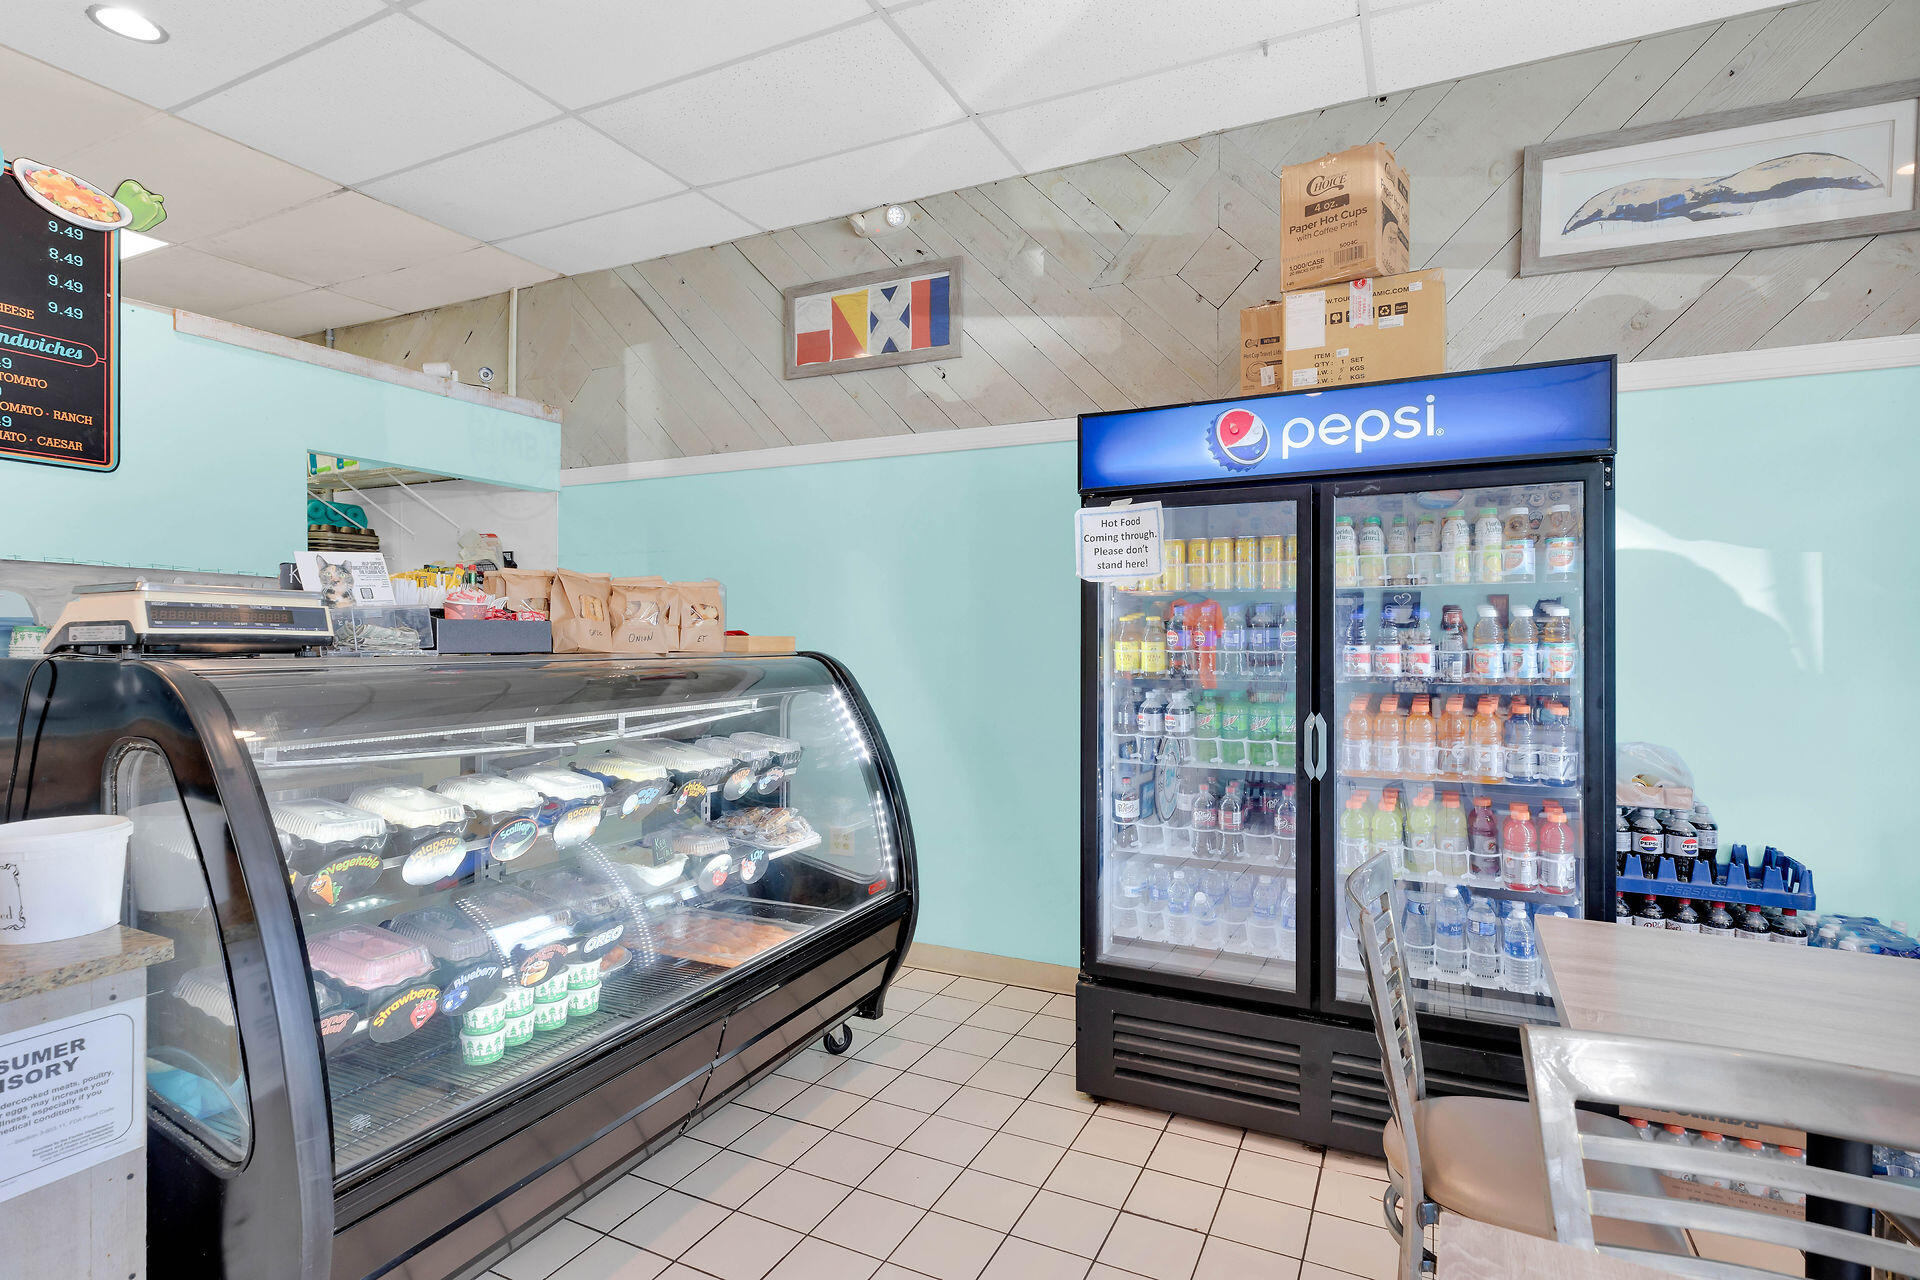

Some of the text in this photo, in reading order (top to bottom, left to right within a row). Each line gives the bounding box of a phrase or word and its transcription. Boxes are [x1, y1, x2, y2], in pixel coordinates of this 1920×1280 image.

[1323, 200, 1338, 210] oz.
[1289, 206, 1368, 235] Paper Hot Cups
[48, 220, 84, 241] 9.49
[1296, 220, 1358, 242] with Coffee Print
[49, 247, 84, 267] 8.49
[48, 274, 84, 293] 9.49
[48, 301, 84, 320] 9.49
[53, 410, 93, 425] RANCH
[37, 436, 83, 451] CAESAR
[1101, 516, 1141, 528] Hot Food
[1083, 530, 1157, 543] Coming through.
[1094, 545, 1149, 556] Please don't
[1097, 558, 1149, 570] stand here!
[326, 855, 380, 874] Vegetable
[454, 966, 498, 989] Blueberry
[373, 988, 440, 1027] Strawberry
[0, 1070, 115, 1111] dercooked meats, poultry,
[5, 1105, 28, 1118] eggs
[31, 1099, 49, 1109] may
[52, 1086, 89, 1102] increase
[91, 1079, 110, 1090] your
[32, 1095, 77, 1117] especially
[78, 1092, 85, 1101] if
[86, 1089, 103, 1100] you
[33, 1105, 82, 1125] conditions.
